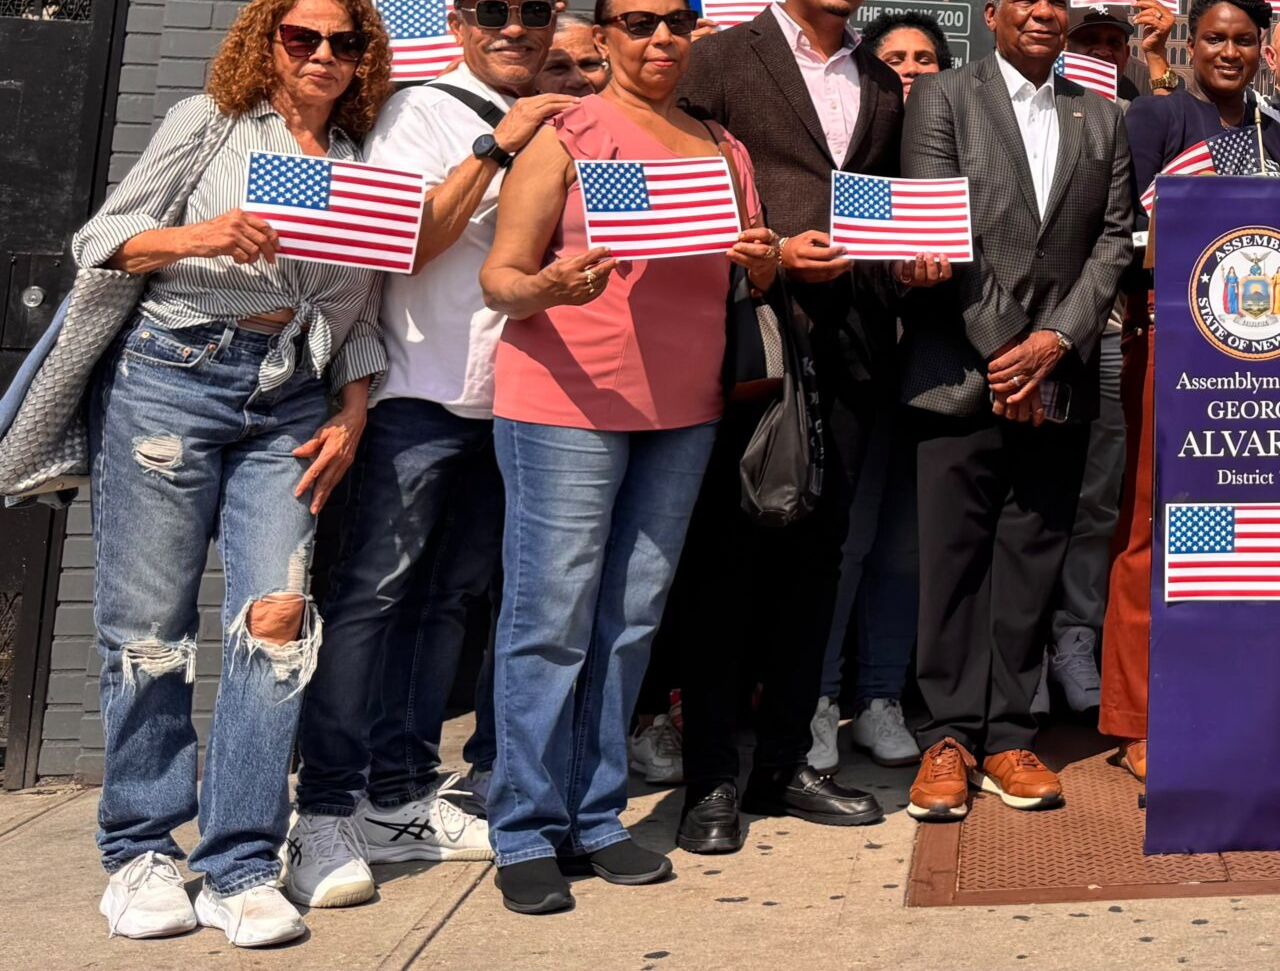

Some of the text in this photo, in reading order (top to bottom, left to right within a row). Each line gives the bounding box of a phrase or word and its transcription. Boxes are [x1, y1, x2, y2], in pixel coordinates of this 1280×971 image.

[937, 10, 964, 27] ZOO
[1198, 297, 1225, 341] STATE
[1227, 335, 1250, 353] OF
[1217, 469, 1275, 485] District
